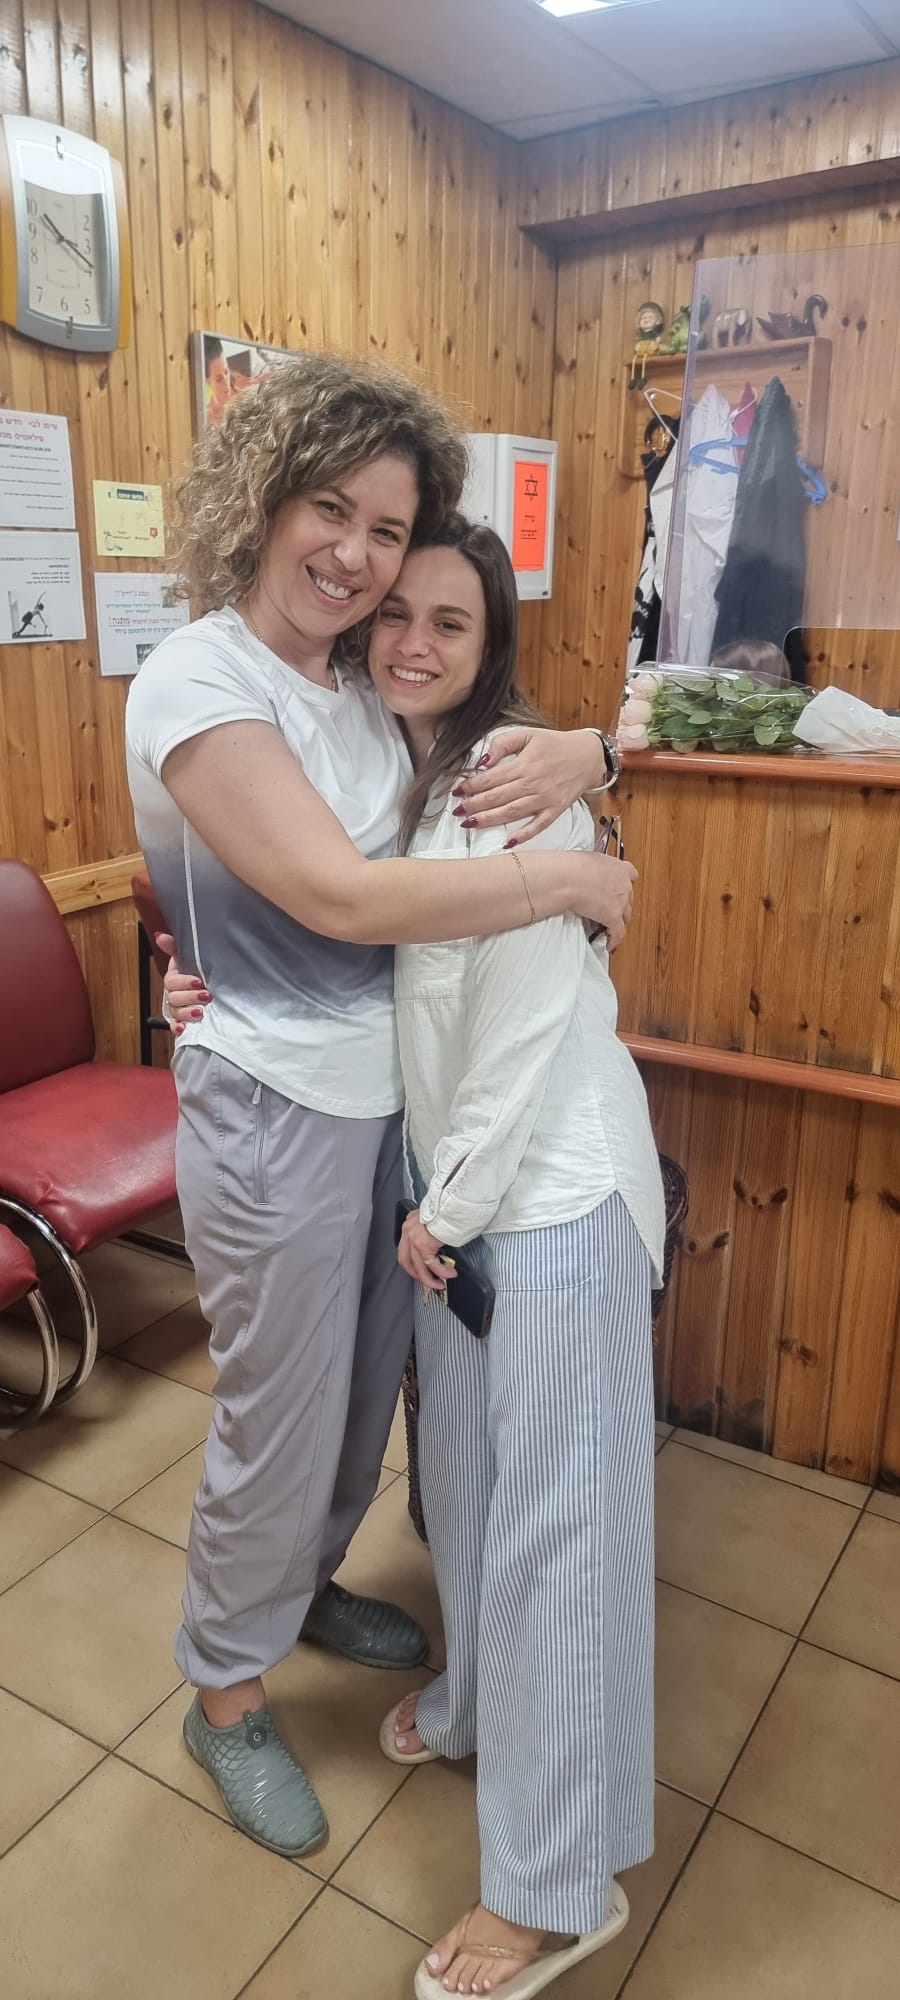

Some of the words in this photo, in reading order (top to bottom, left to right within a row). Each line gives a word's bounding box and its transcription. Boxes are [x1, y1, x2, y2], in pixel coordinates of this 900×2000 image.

[26, 197, 38, 217] 10
[28, 222, 37, 239] 9
[83, 214, 90, 232] 2
[31, 247, 39, 264] 8
[36, 285, 43, 303] 7
[60, 296, 69, 312] 6
[83, 298, 91, 314] 5
